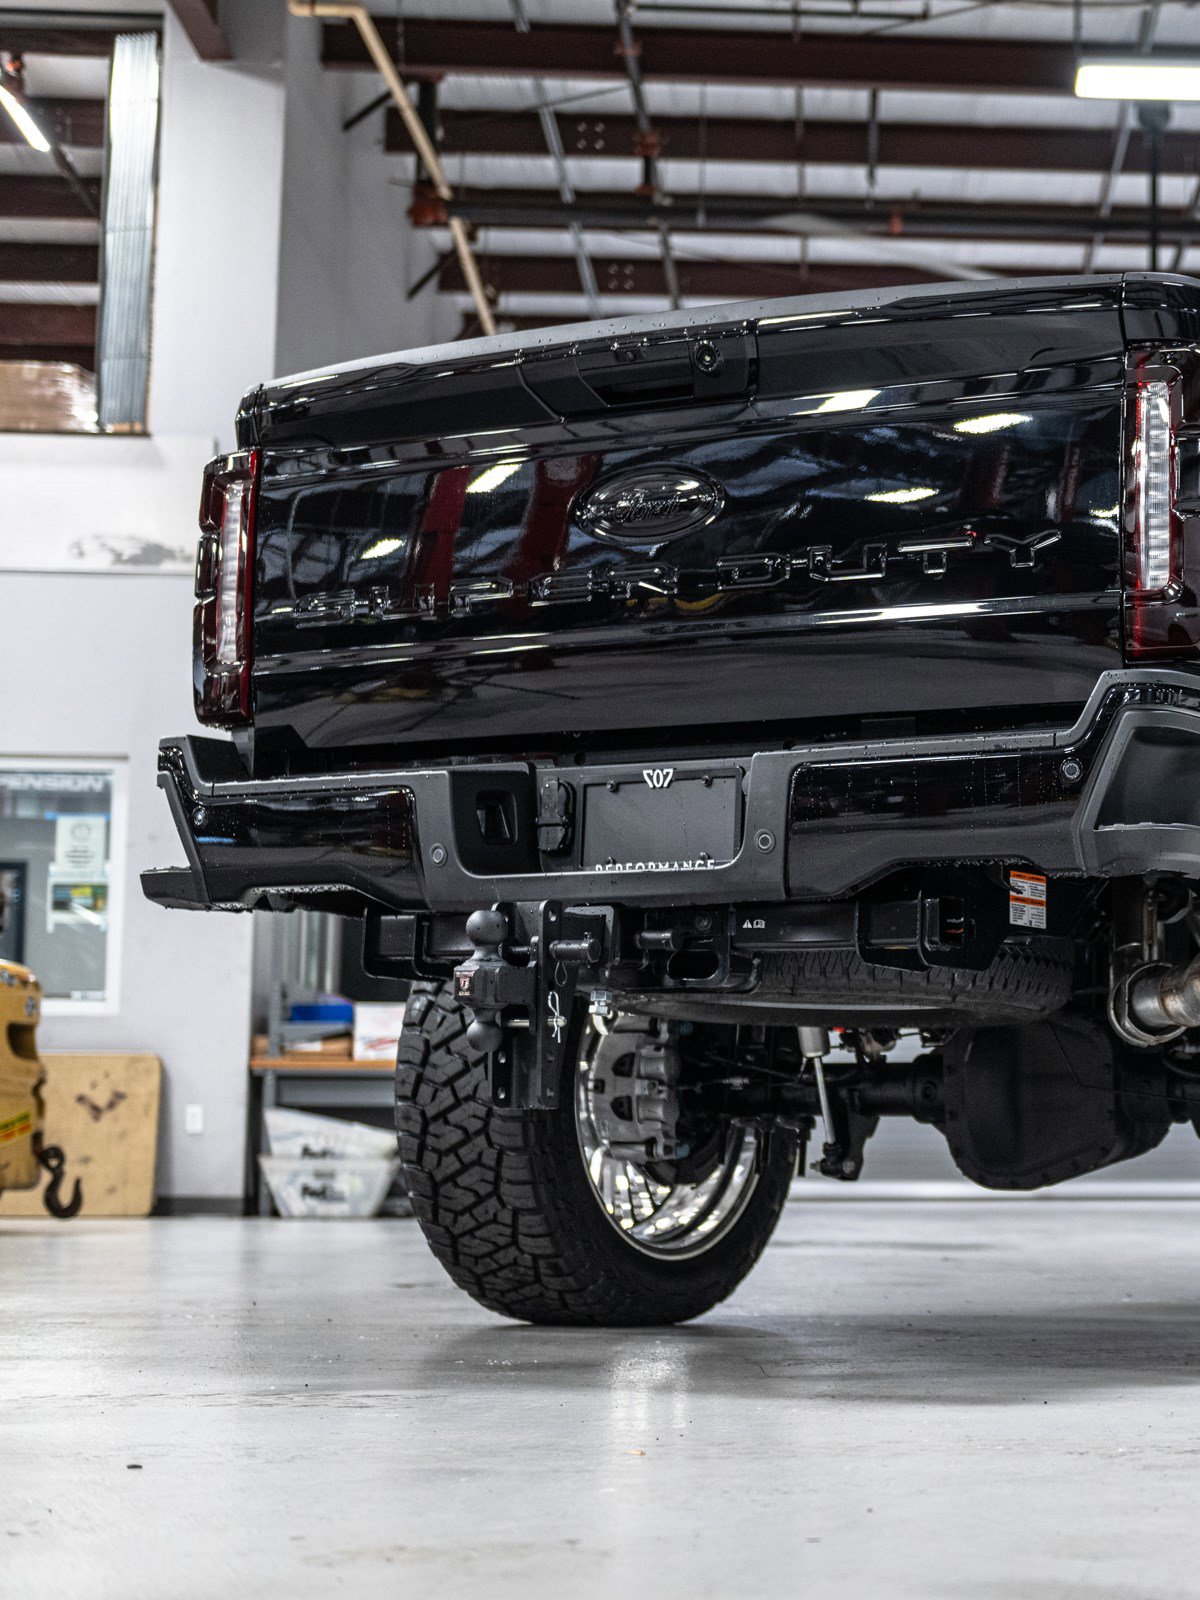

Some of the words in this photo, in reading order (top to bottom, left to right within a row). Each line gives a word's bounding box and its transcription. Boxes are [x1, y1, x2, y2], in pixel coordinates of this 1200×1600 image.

[296, 561, 678, 629] SUPER
[717, 529, 1062, 591] DUTY
[642, 768, 674, 788] 707
